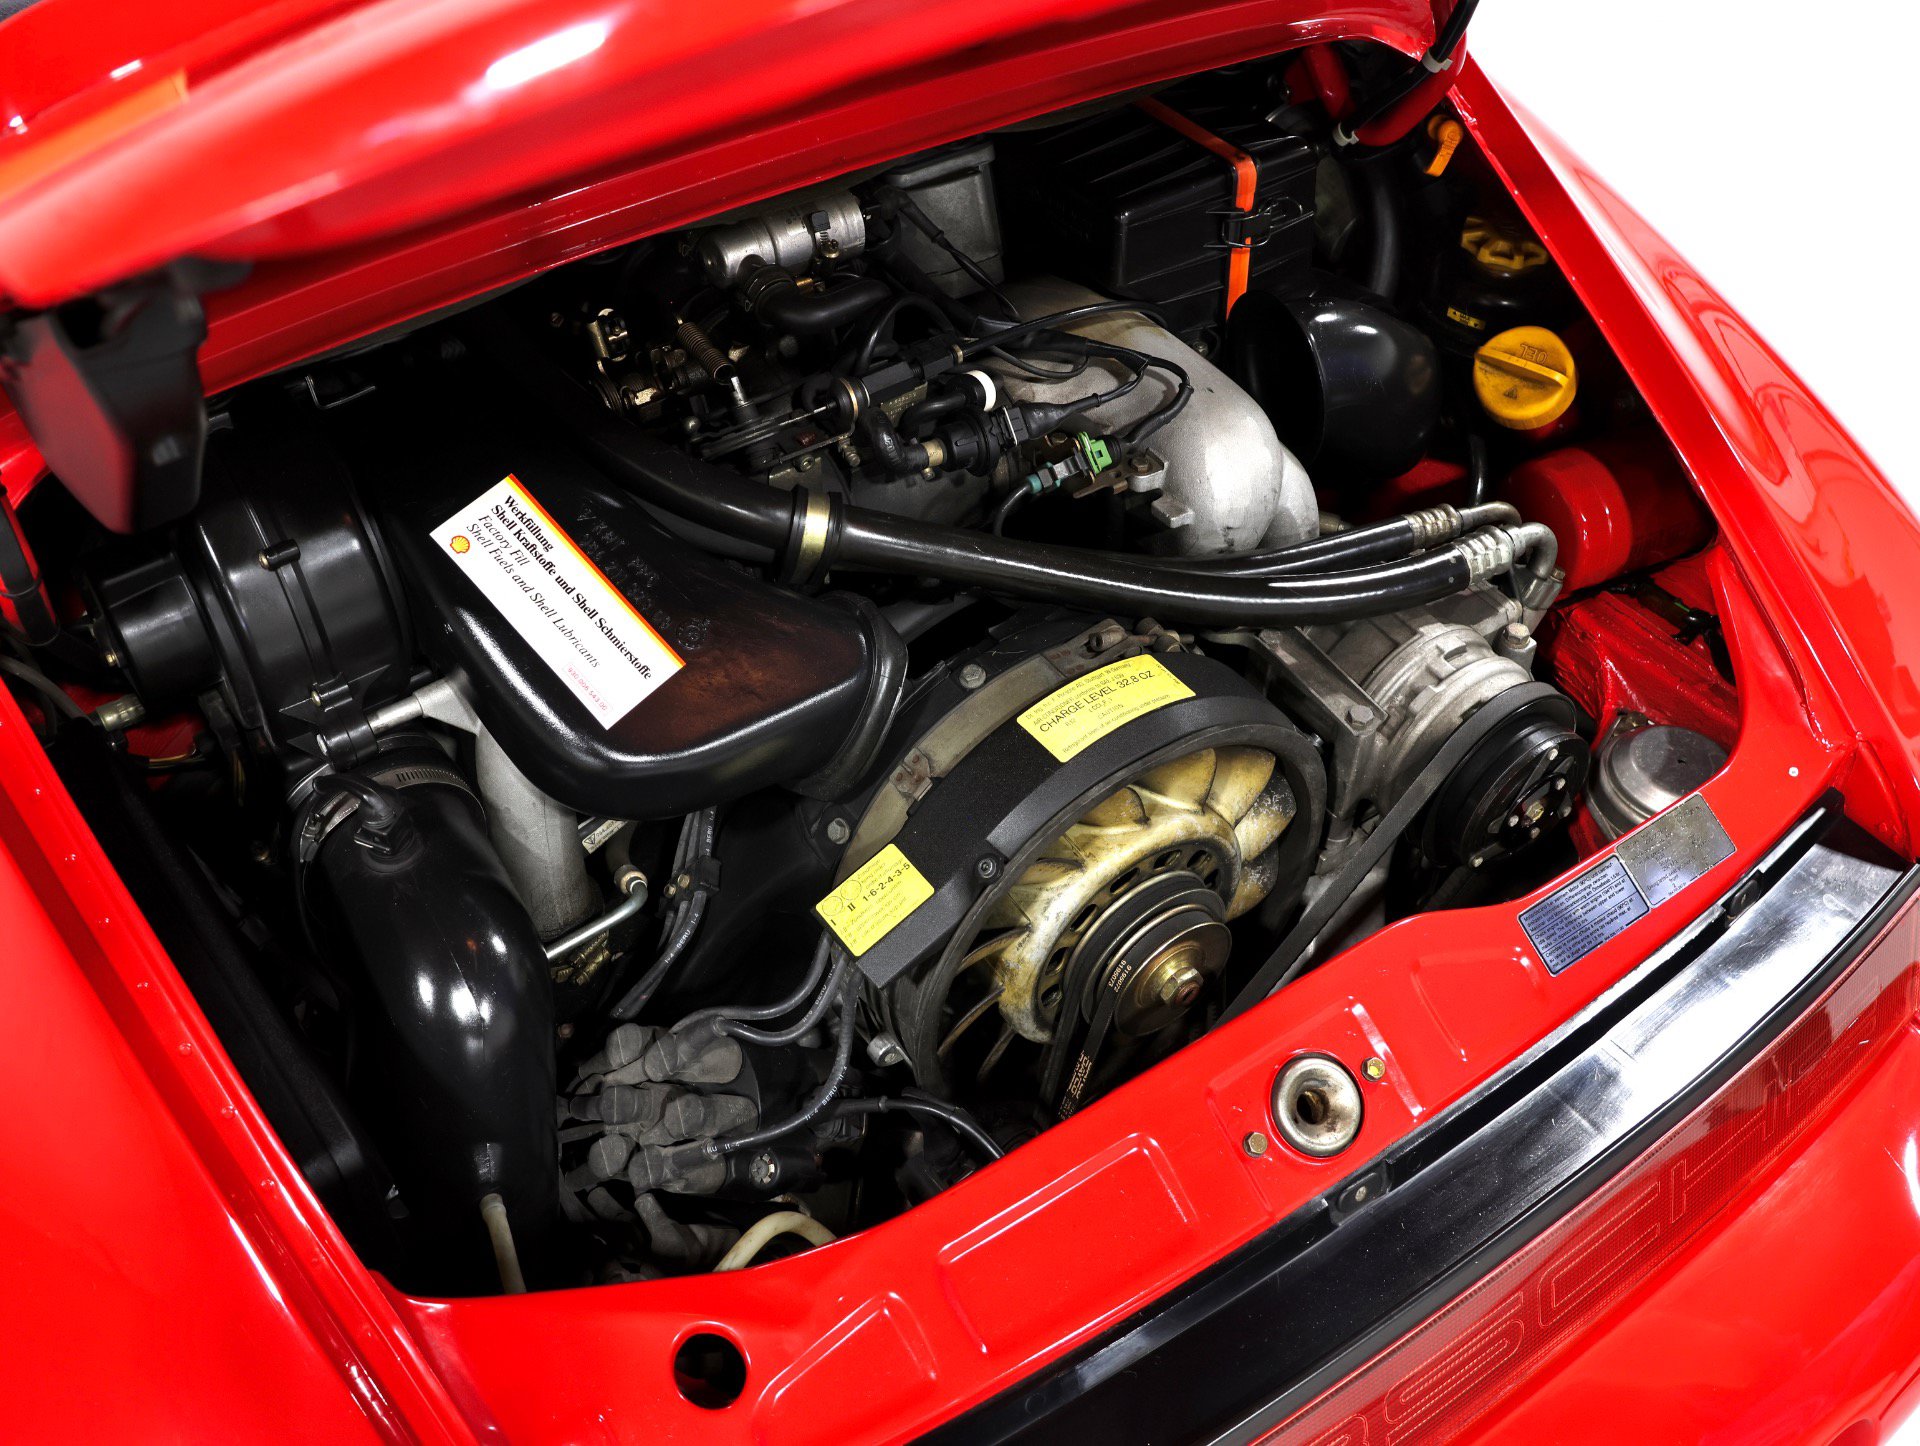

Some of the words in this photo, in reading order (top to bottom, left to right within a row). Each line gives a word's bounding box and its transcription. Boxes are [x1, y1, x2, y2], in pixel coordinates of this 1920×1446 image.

[478, 516, 509, 548] Factory
[510, 550, 529, 565] Fill
[505, 496, 553, 552] Werkfüllung
[467, 524, 493, 547] Shell
[489, 548, 513, 573] Fuels
[512, 576, 534, 592] and
[530, 593, 557, 617] Shell
[553, 619, 597, 667] Lubricants
[491, 505, 517, 530] Shell
[513, 529, 556, 575] Kraftstoffe
[555, 576, 575, 595] und
[572, 593, 598, 619] Shell
[595, 618, 651, 679] Schmierstoffe
[1040, 702, 1084, 732] CHARGE
[1084, 686, 1117, 705] LEVEL
[1116, 675, 1139, 689] 32,8
[1139, 670, 1155, 680] OZ
[862, 863, 910, 902] 1-6-2-4-3-5
[676, 929, 691, 948] BERU
[1114, 964, 1132, 993] 9195072
